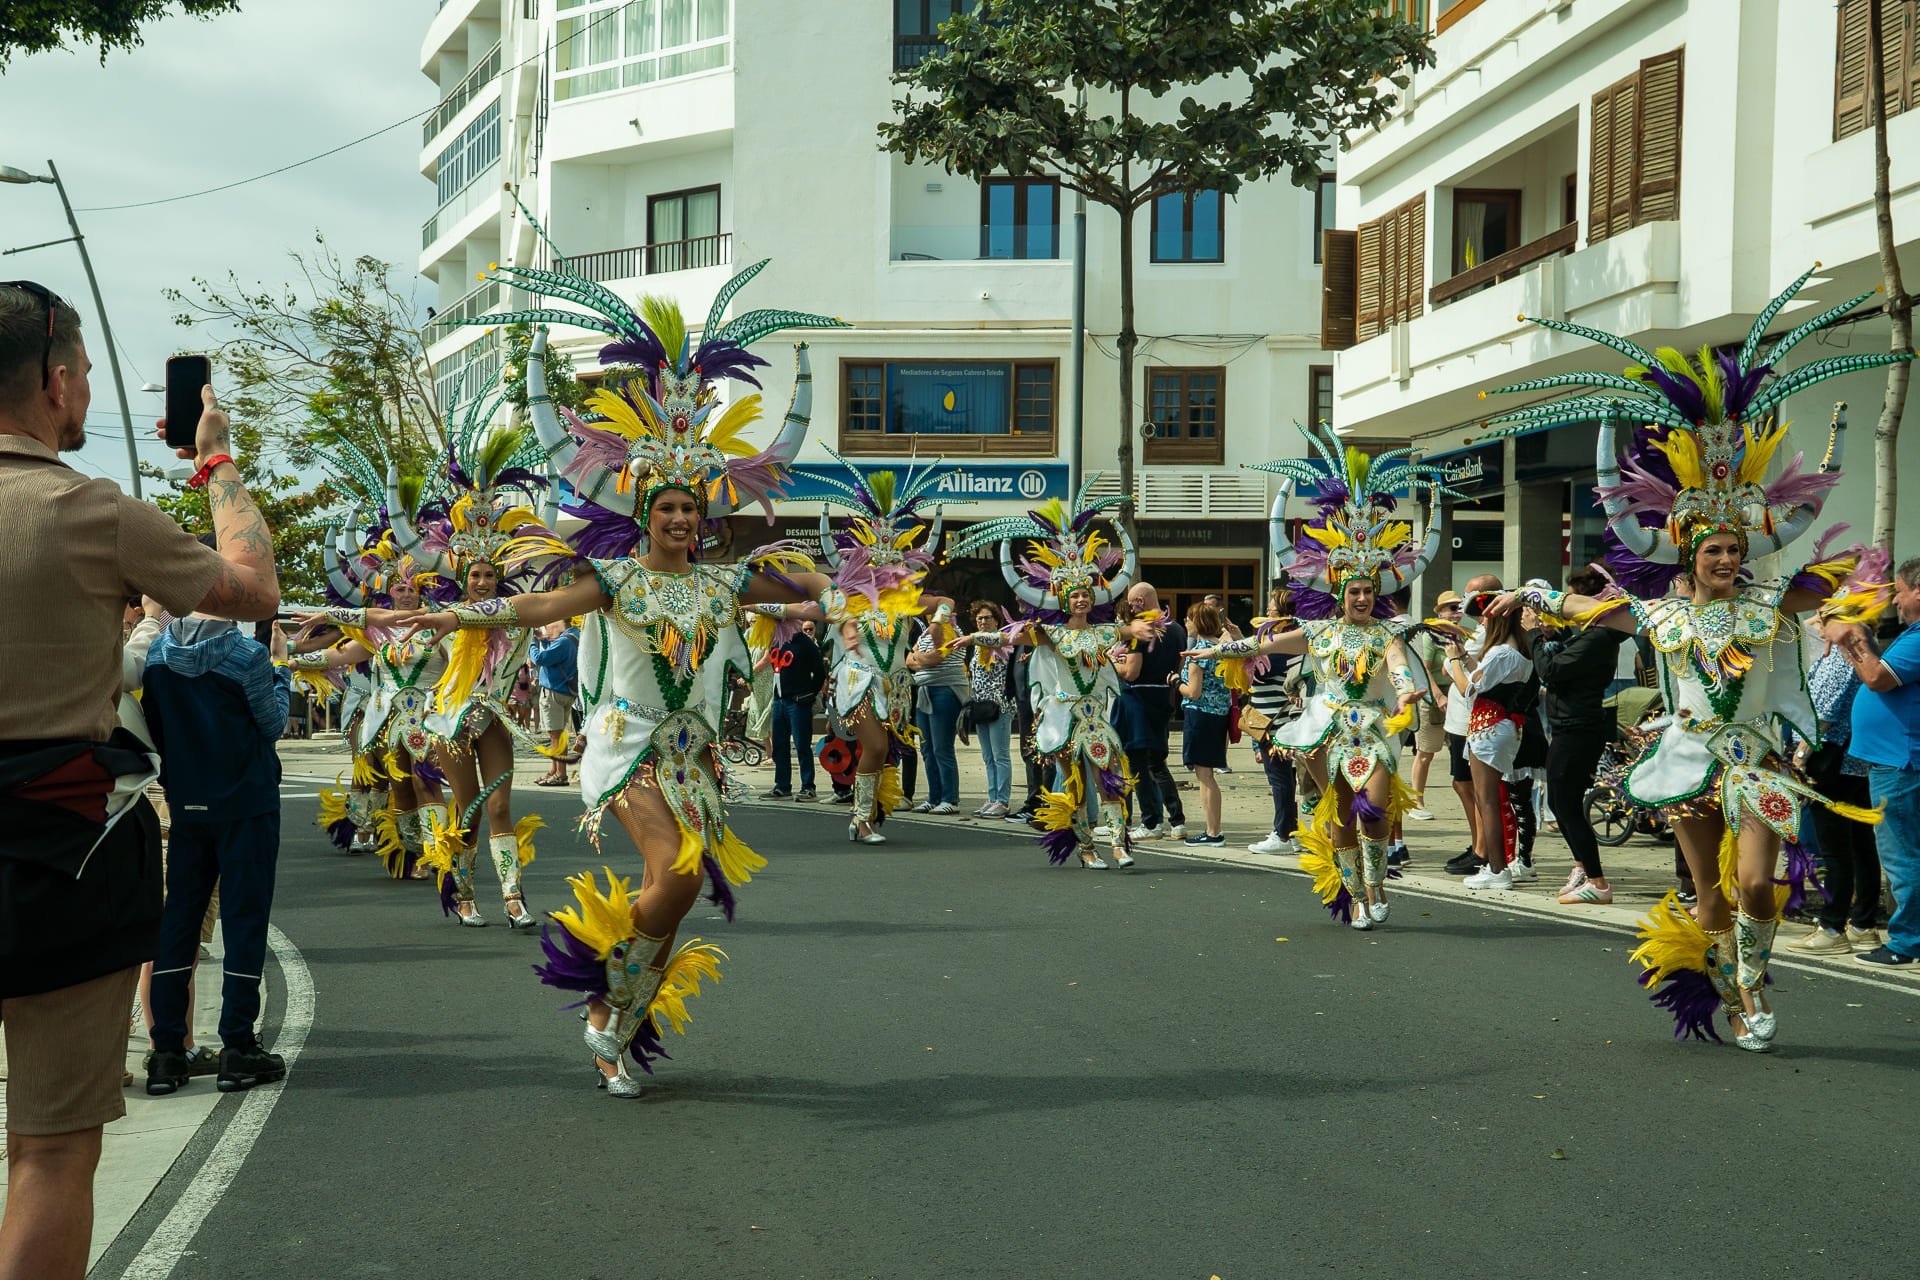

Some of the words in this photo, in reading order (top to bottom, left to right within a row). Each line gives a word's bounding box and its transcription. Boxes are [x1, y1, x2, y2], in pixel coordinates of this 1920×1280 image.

[941, 369, 963, 377] Seguros
[1444, 455, 1483, 482] CaixaBank
[937, 472, 1014, 493] Allianz
[785, 528, 820, 537] DESAYUN
[945, 530, 994, 560] BAR
